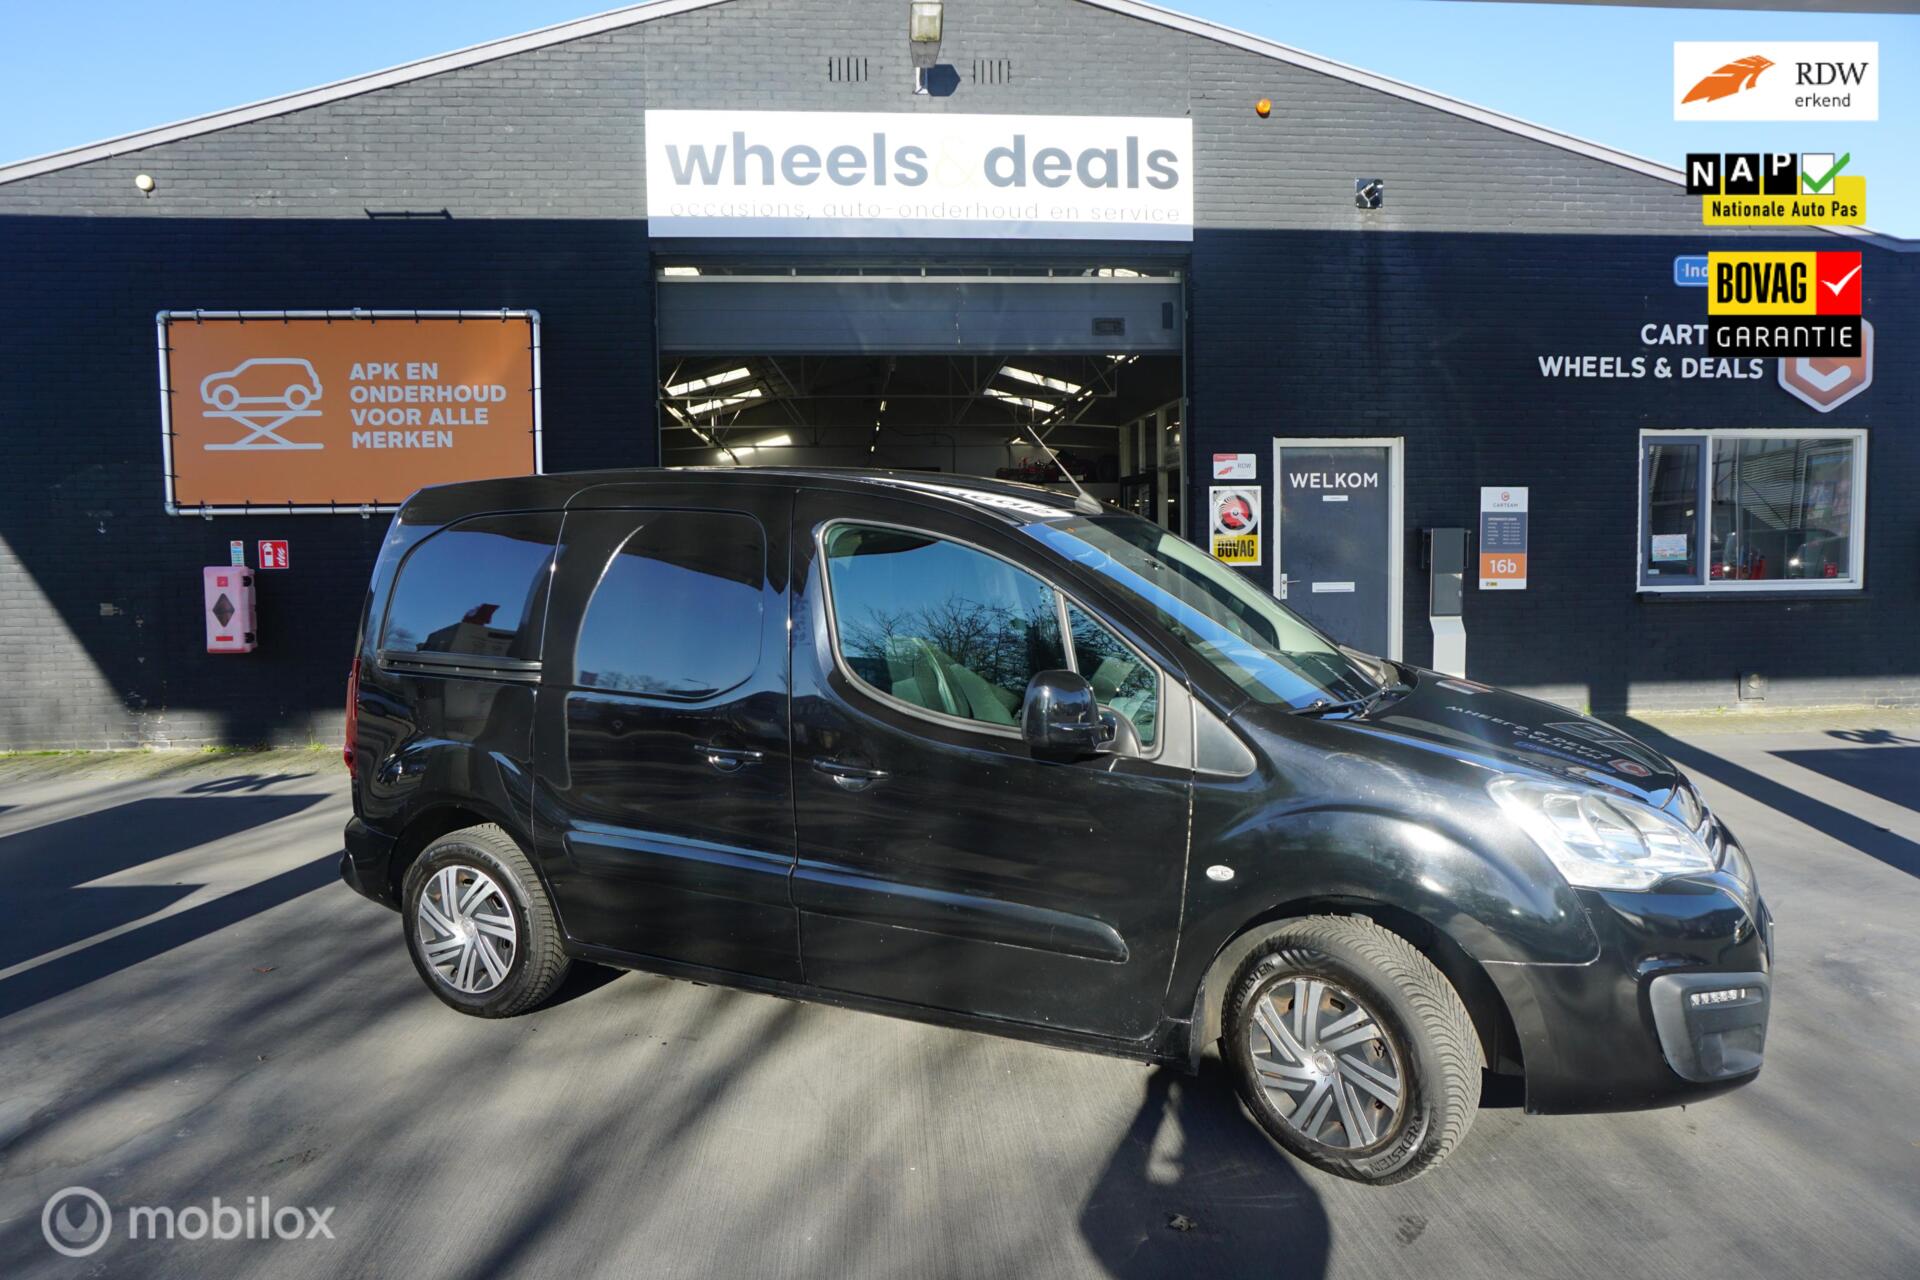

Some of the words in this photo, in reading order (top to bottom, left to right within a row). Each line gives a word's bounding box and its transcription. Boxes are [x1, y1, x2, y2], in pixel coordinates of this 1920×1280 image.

[665, 131, 929, 188] wheels
[983, 134, 1180, 191] deals
[1050, 206, 1079, 221] en
[1090, 204, 1181, 223] service
[1640, 323, 1709, 346] CART
[349, 362, 400, 381] APK
[406, 362, 438, 380] EN
[1538, 356, 1647, 378] WHEELS
[1653, 357, 1673, 379] &
[1681, 358, 1764, 380] DEALS
[349, 384, 507, 403] ONDERHOUD
[350, 408, 422, 426] VOOR
[428, 407, 489, 426] ALLE
[351, 430, 454, 449] MERKEN
[1289, 472, 1379, 489] WELKOM
[1217, 539, 1255, 558] BOVAG
[1489, 558, 1517, 574] 16b
